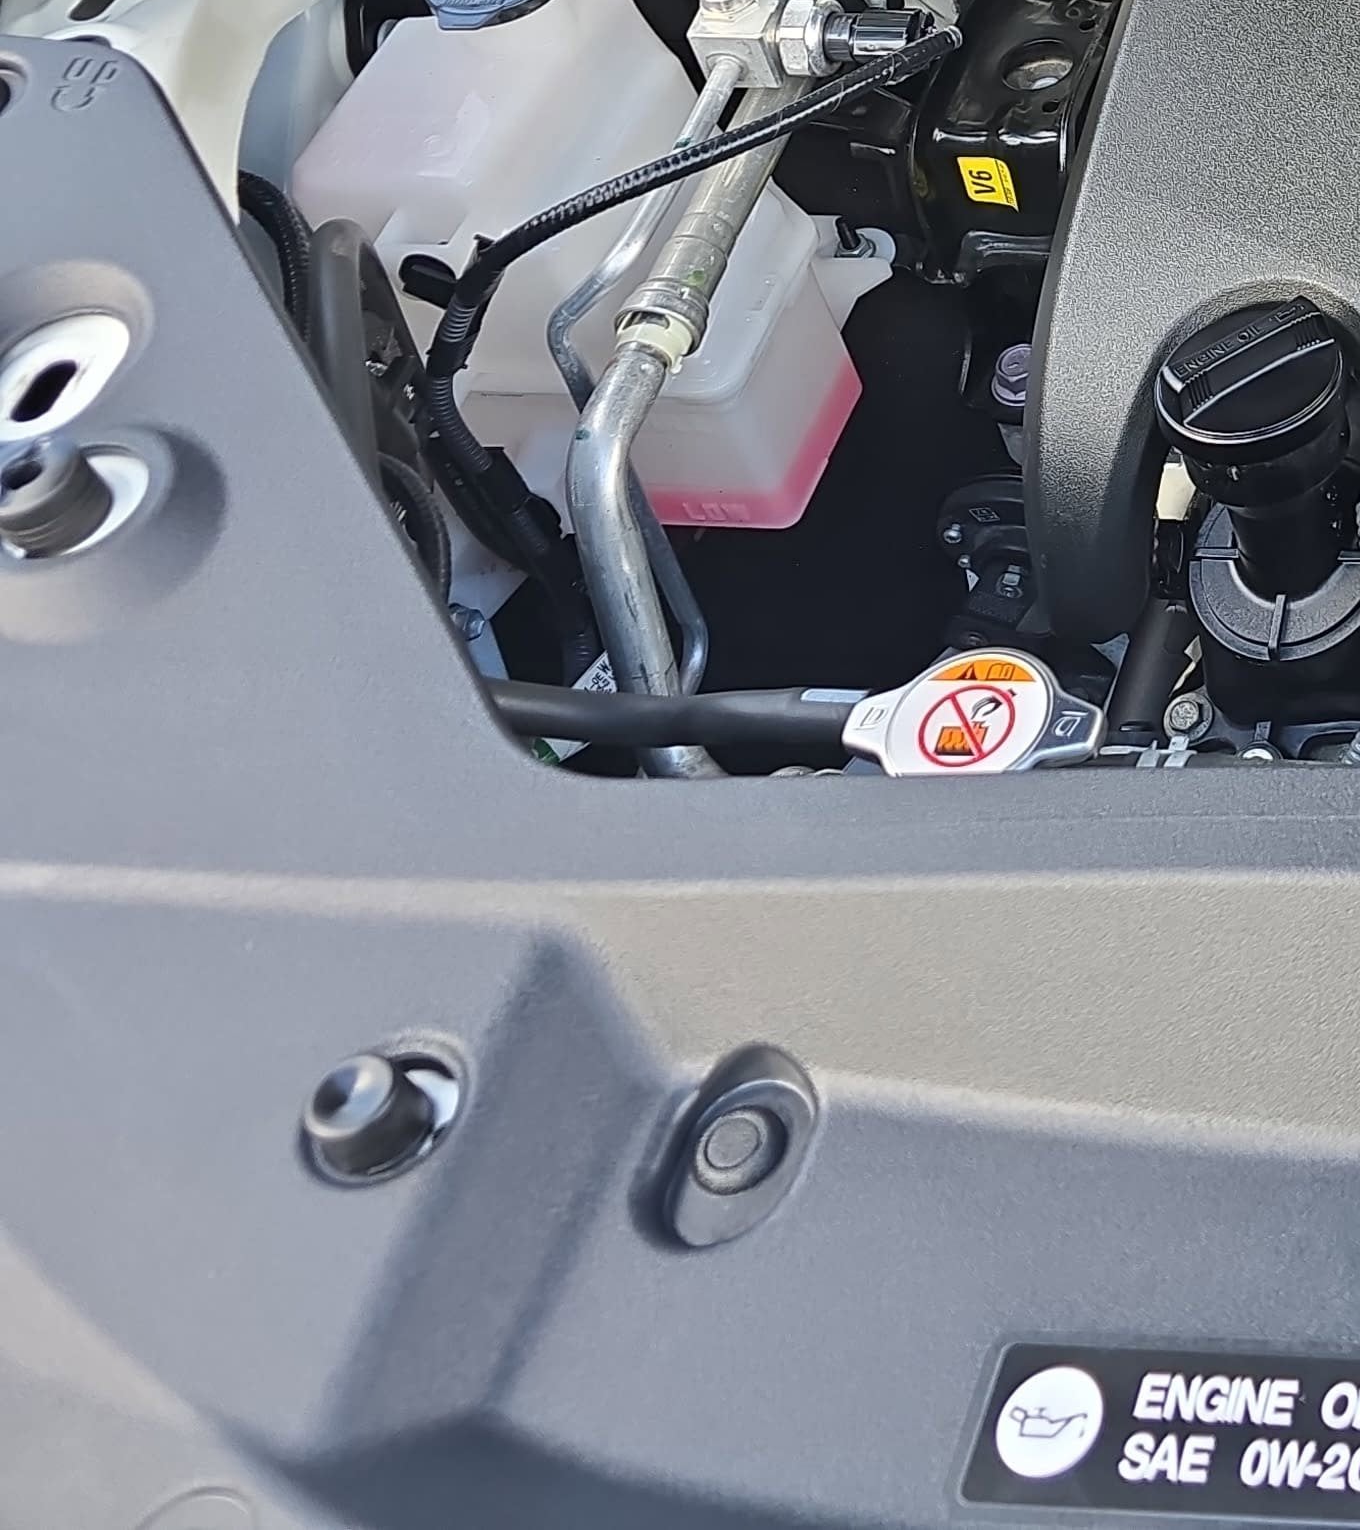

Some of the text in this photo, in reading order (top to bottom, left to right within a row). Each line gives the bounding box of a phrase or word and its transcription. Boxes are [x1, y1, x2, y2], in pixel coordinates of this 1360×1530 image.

[968, 169, 996, 194] V6
[1174, 323, 1263, 378] ENGINE OIL
[1133, 1371, 1301, 1427] ENGINE
[1117, 1431, 1217, 1485] SAE
